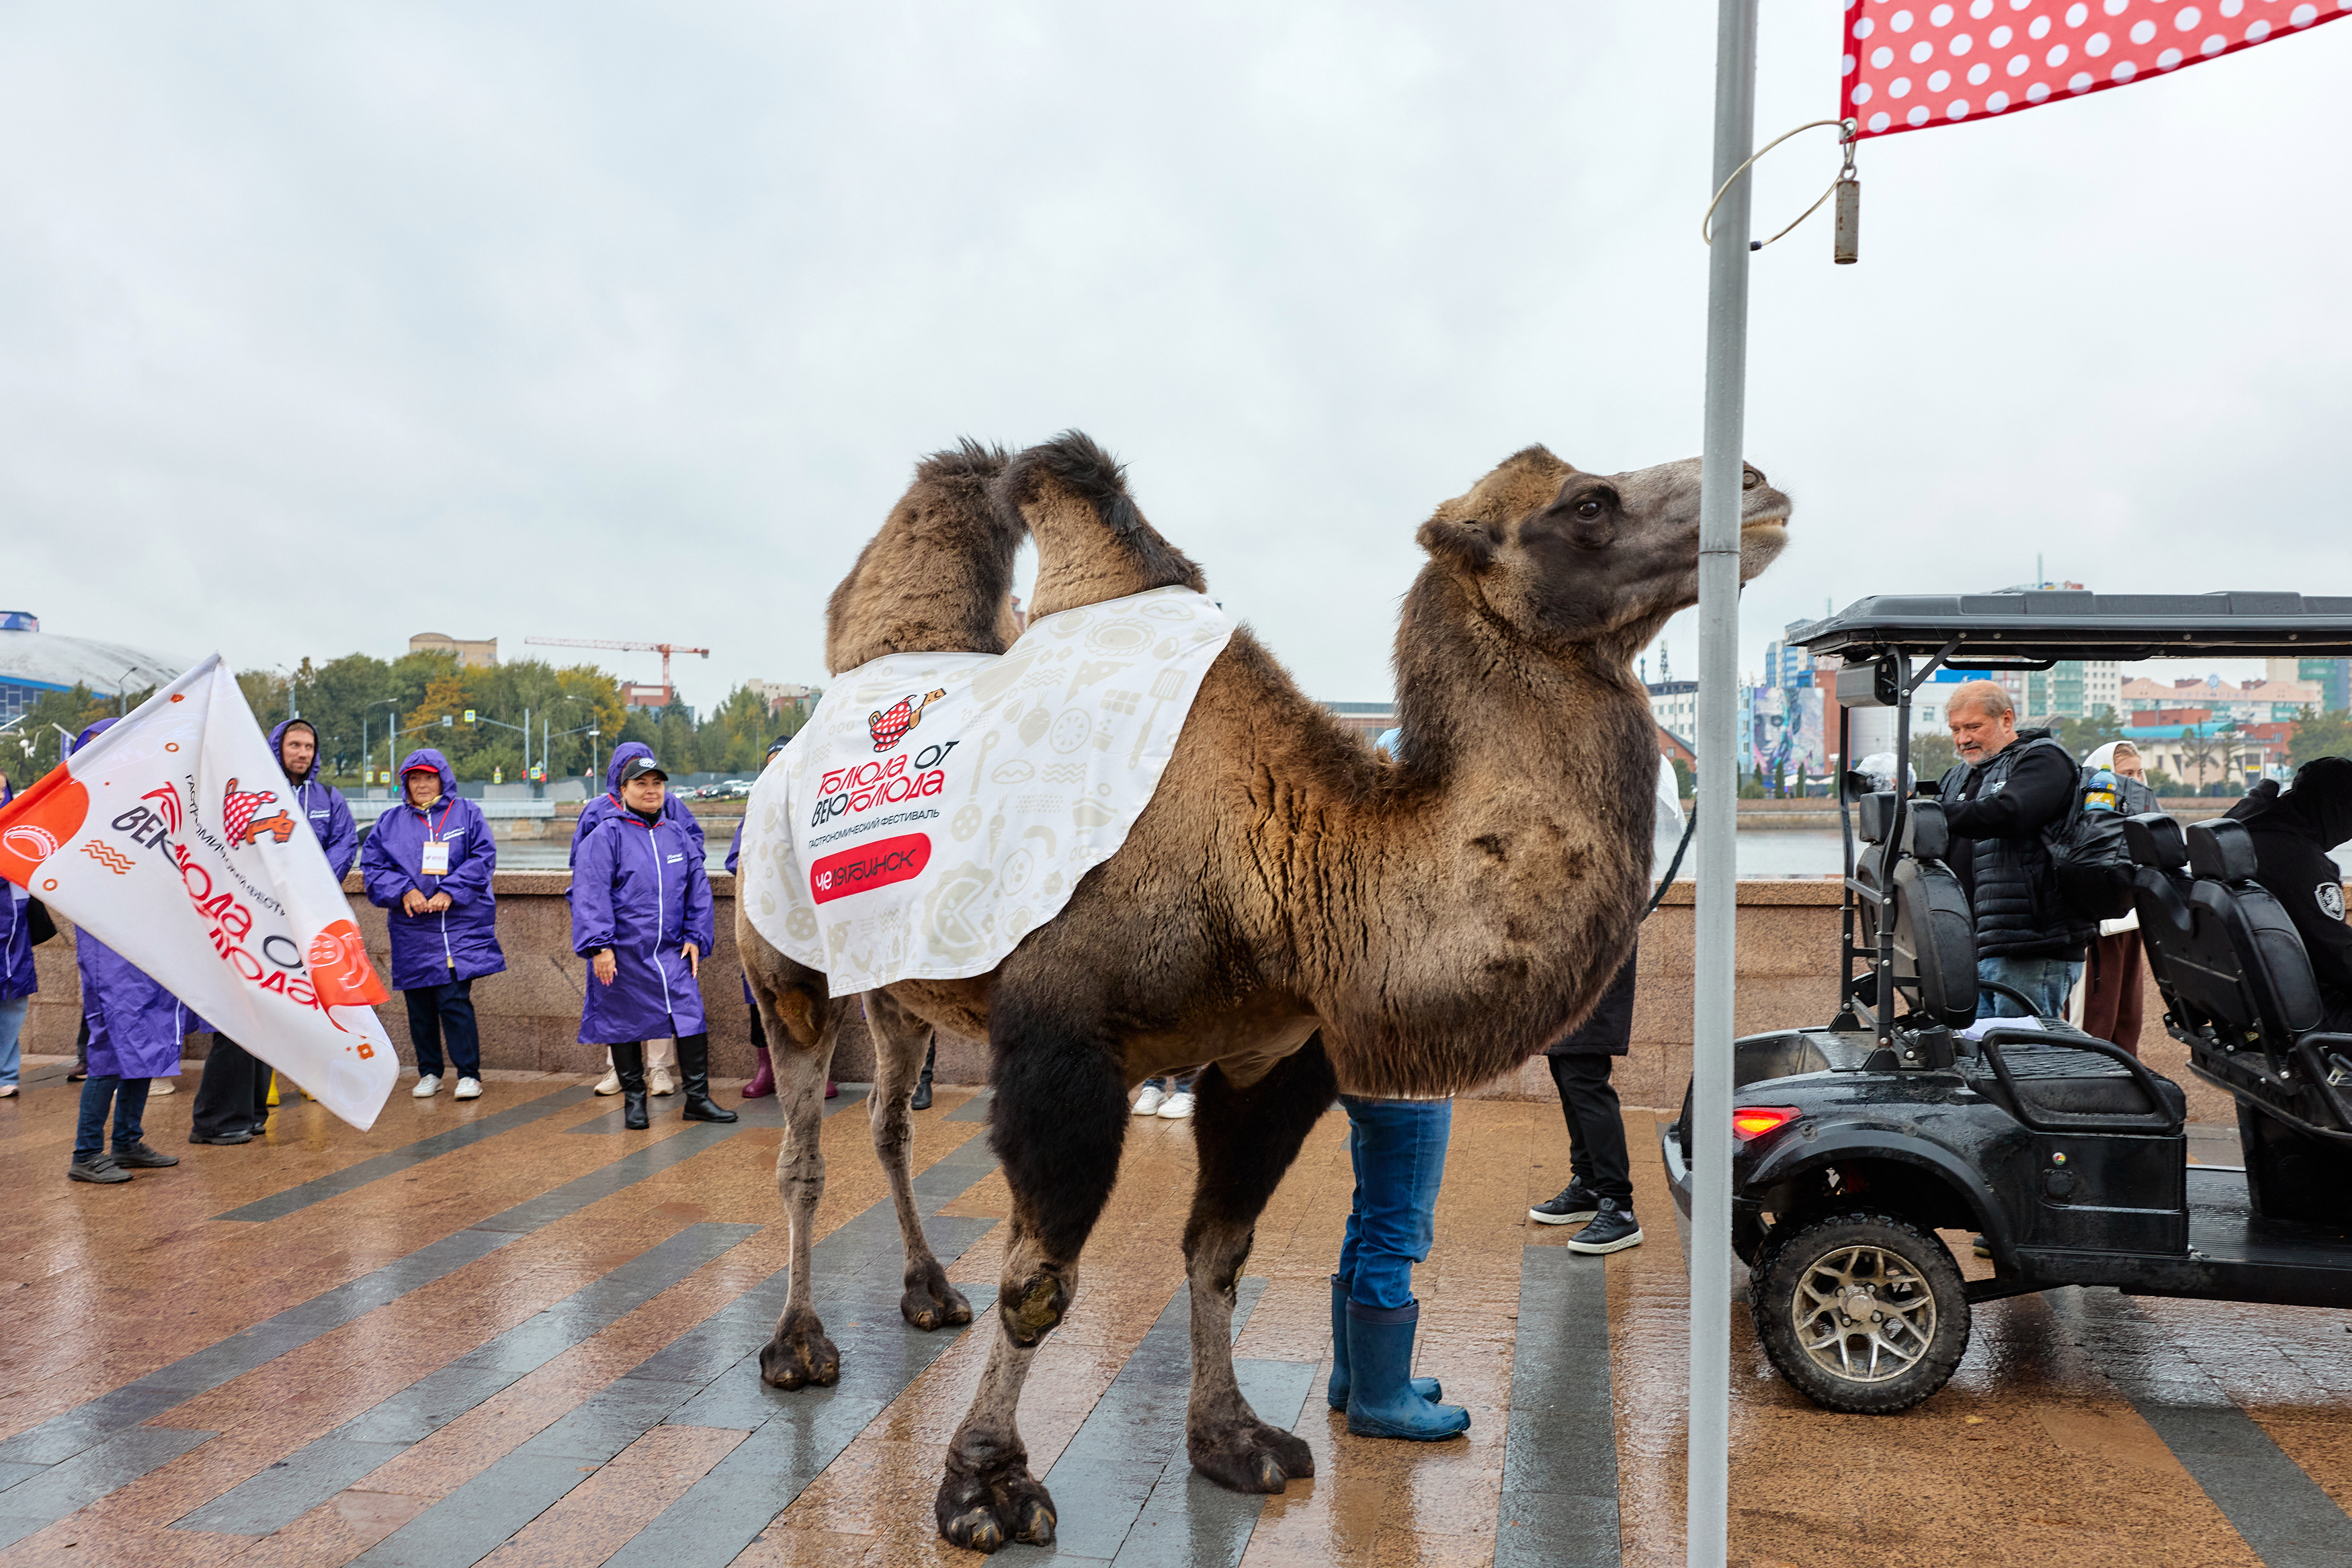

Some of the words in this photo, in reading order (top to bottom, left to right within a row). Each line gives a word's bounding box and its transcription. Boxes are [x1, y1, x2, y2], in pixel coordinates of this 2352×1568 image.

[914, 740, 960, 769] ОТ
[808, 817, 880, 849] ГАСТРОНОМИЧЕСКИЙ
[880, 809, 940, 826] ФЕСТИВАЛЬ
[262, 934, 308, 977] О
